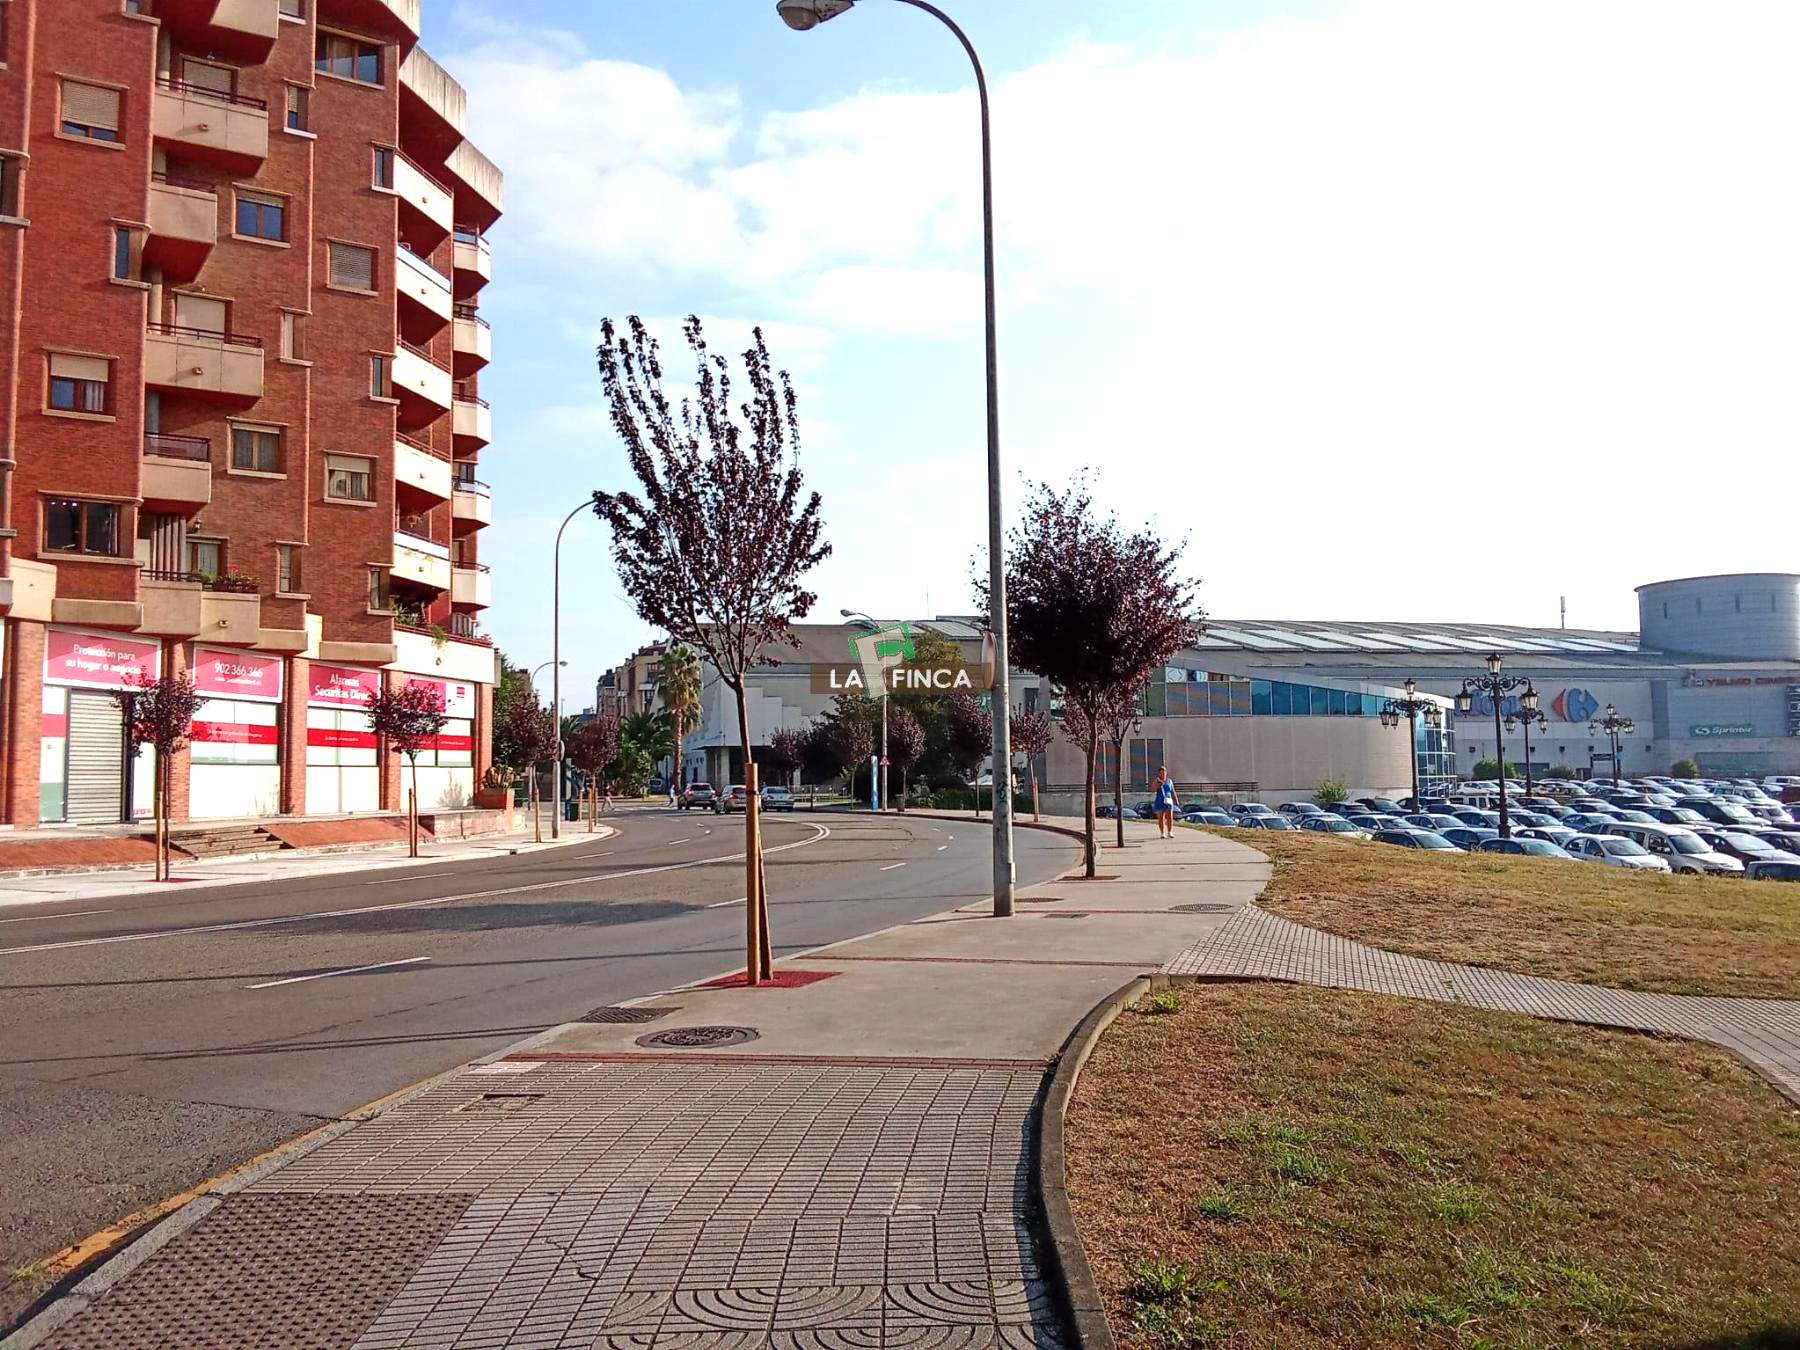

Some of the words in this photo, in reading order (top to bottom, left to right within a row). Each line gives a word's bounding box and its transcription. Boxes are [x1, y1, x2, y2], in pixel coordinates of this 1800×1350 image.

[73, 644, 116, 659] Protección
[117, 651, 135, 661] para
[65, 659, 76, 667] su
[77, 658, 101, 672] hogar
[110, 664, 141, 675] negocio
[215, 662, 230, 674] 902
[231, 664, 246, 677] 366
[247, 666, 263, 678] 366
[329, 672, 359, 687] Alarmas
[314, 684, 349, 699] Securitas
[1712, 726, 1753, 735] Sprinter
